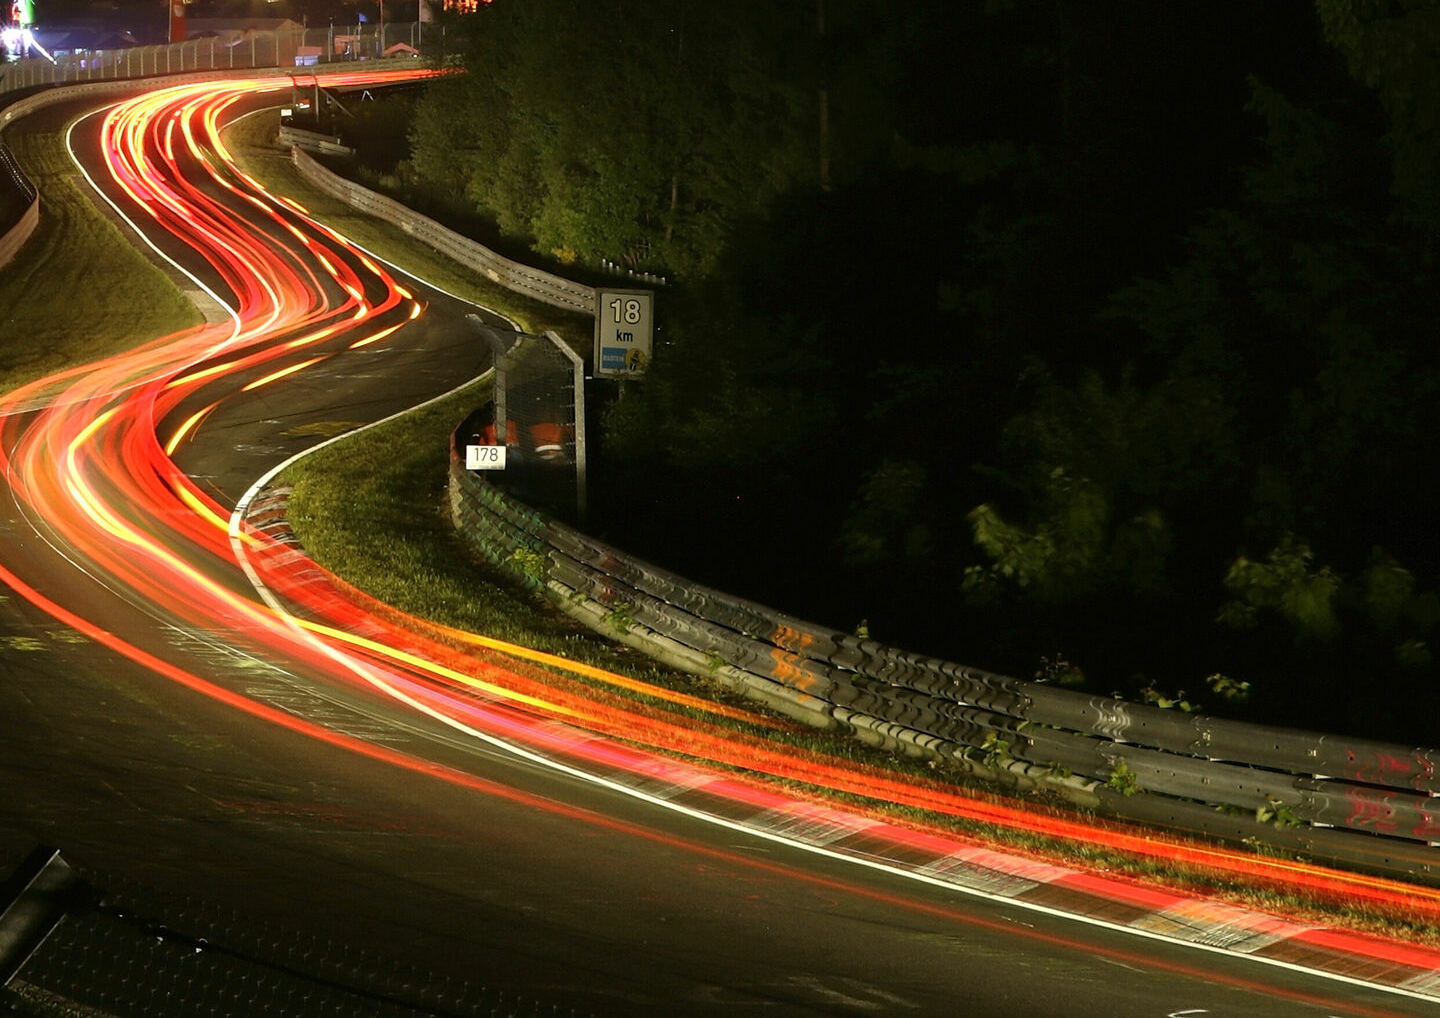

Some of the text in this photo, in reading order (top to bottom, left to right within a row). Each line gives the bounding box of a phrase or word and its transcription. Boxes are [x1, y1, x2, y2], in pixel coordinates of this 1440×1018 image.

[610, 298, 641, 325] 18
[616, 329, 633, 342] km
[474, 447, 498, 462] 178
